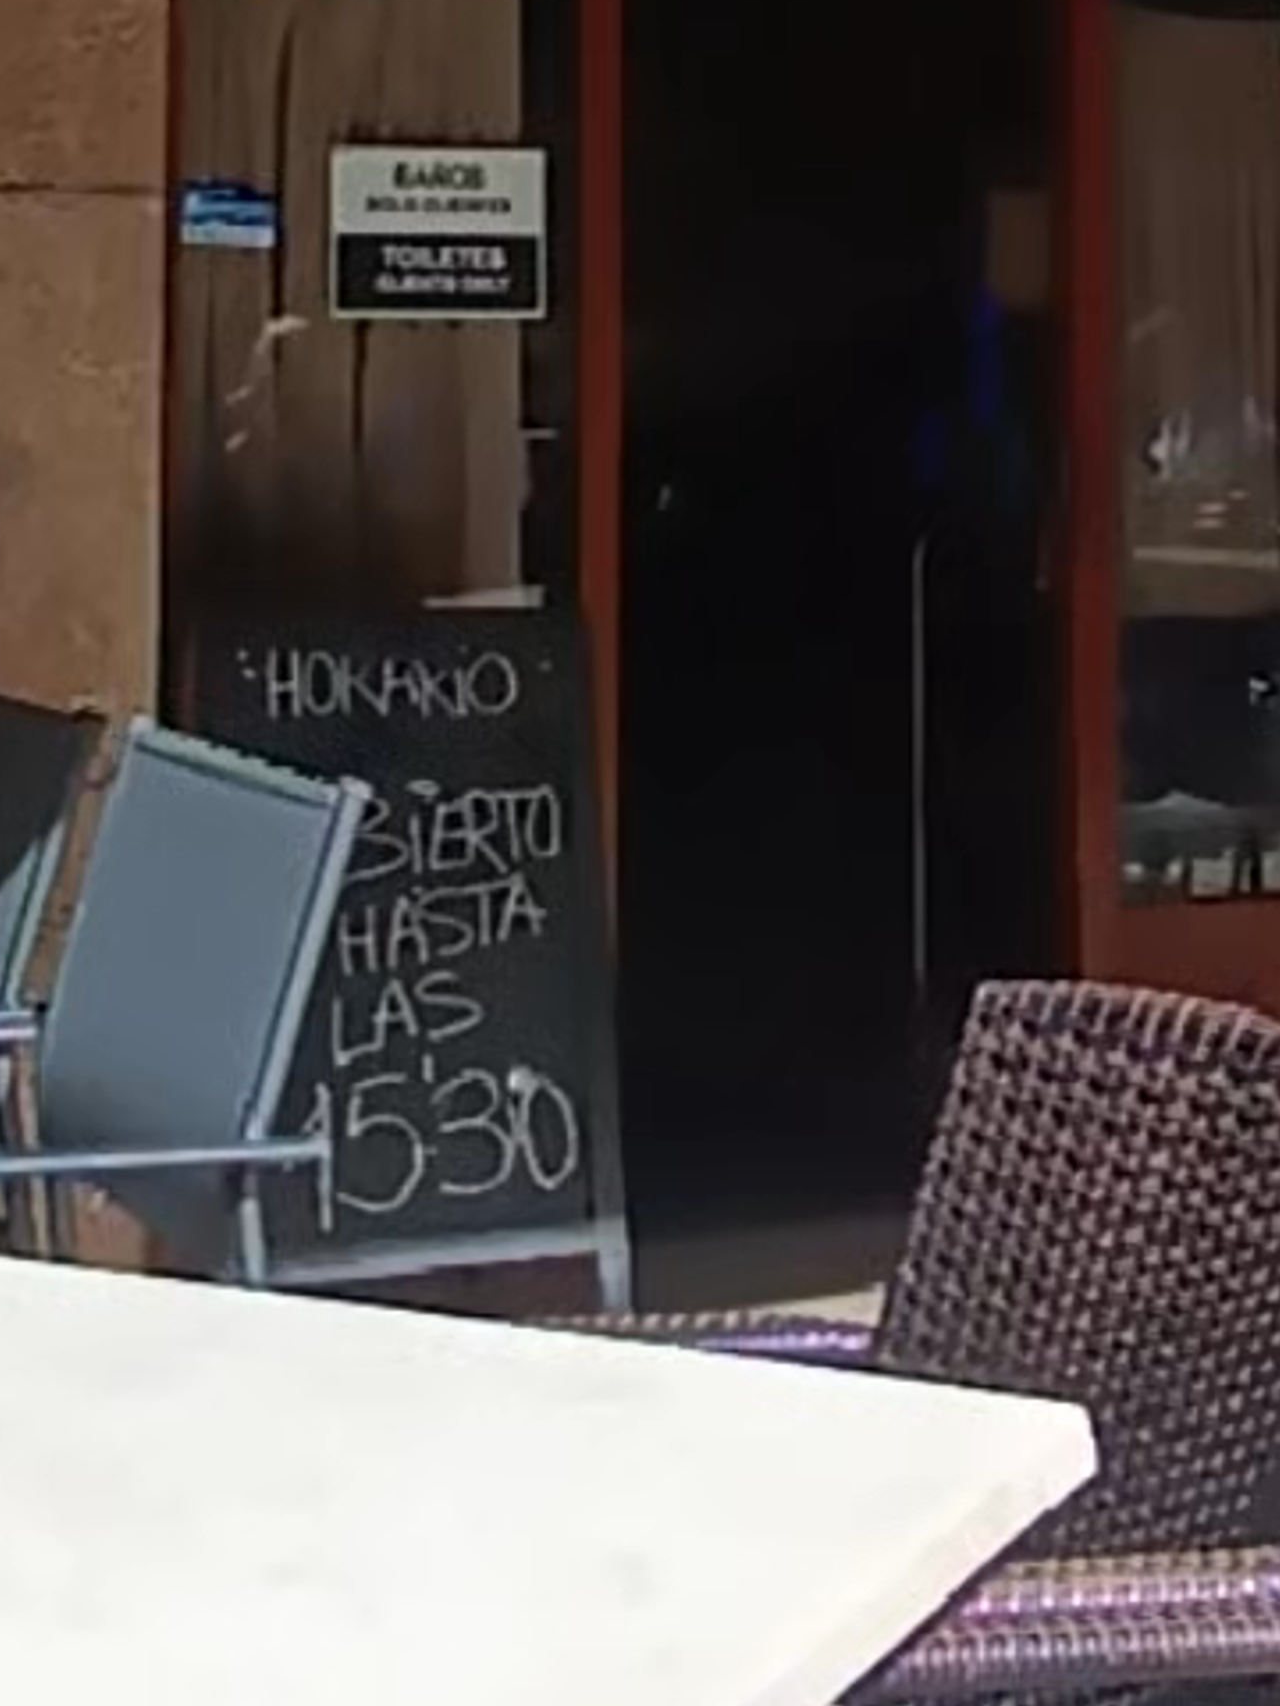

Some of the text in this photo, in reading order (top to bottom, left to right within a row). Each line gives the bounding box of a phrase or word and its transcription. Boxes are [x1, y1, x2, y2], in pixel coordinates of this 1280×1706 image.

[266, 646, 518, 719] HORARIO
[344, 782, 562, 883] BIERTO
[337, 872, 547, 977] HASTA
[331, 970, 484, 1068] LAS
